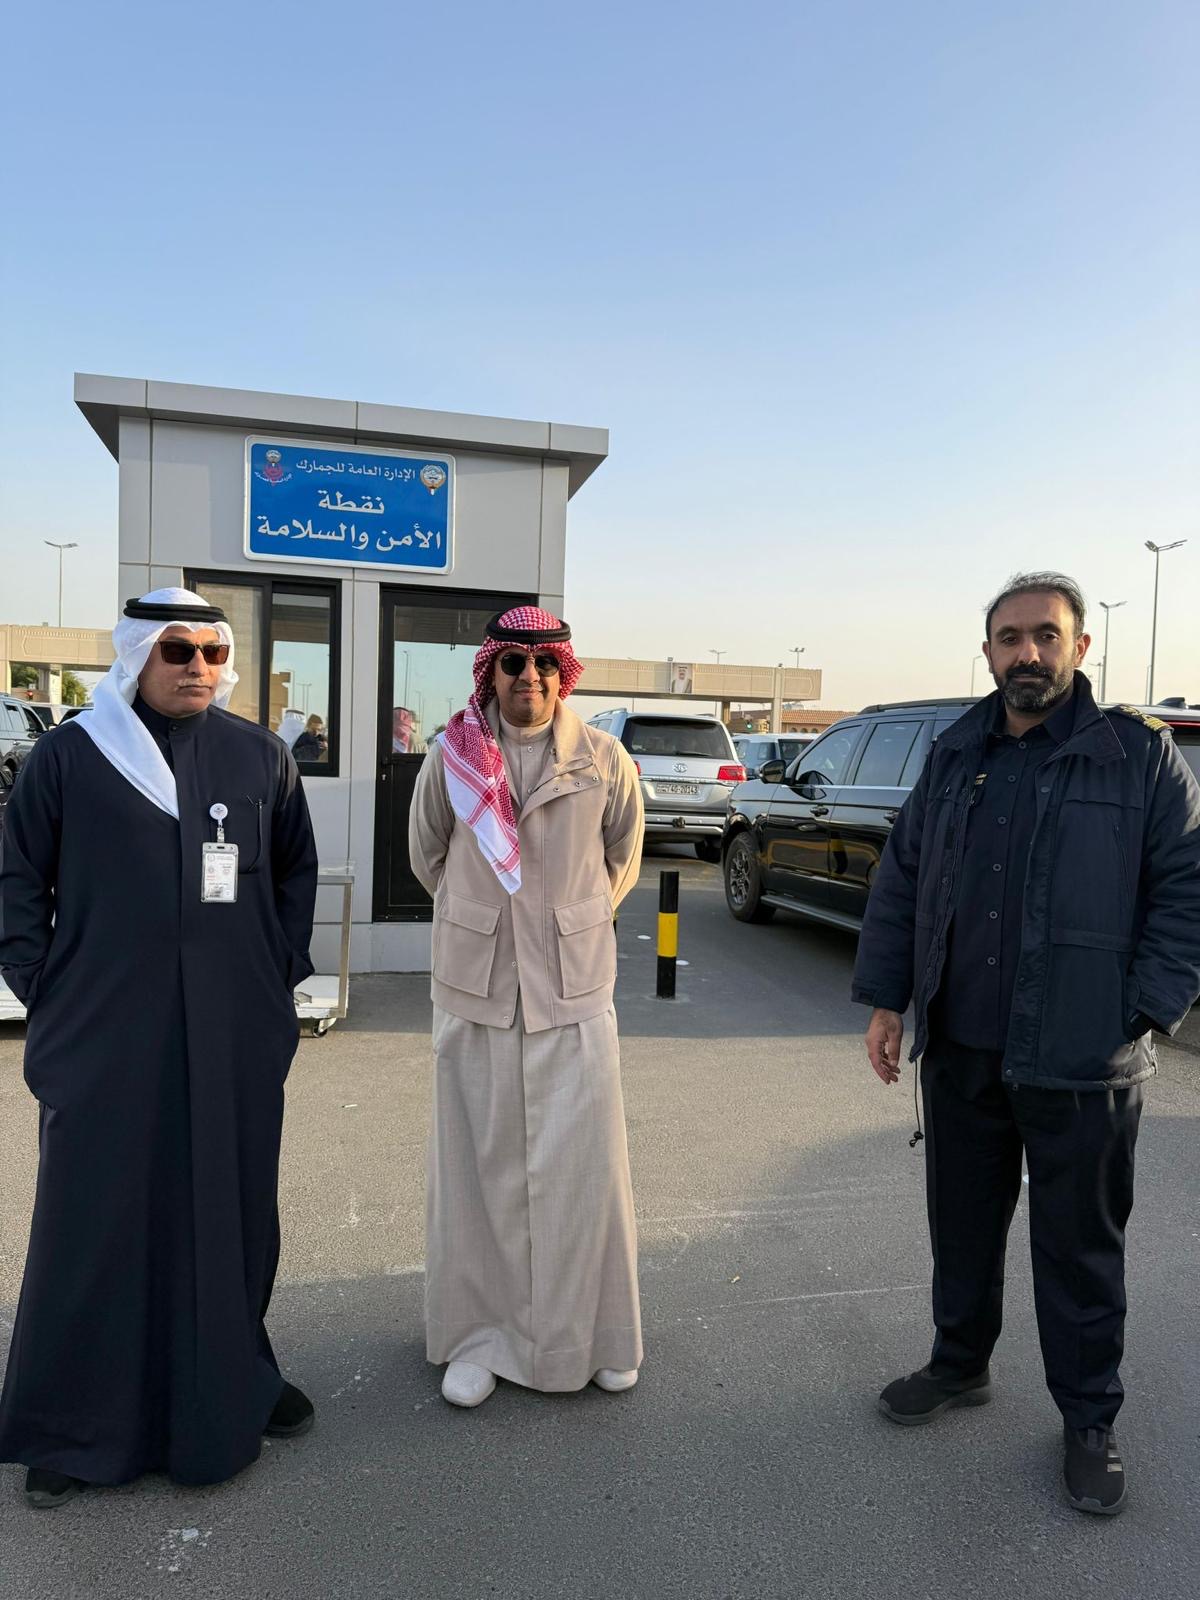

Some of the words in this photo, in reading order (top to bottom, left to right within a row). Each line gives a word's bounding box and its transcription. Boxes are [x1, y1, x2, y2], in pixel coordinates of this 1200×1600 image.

[296, 459, 345, 473] للجمارك
[348, 464, 382, 476] العامة
[384, 468, 416, 482] الإدارة
[318, 489, 385, 514] نقطة
[256, 515, 369, 550] والسلامة
[375, 522, 441, 552] الأمن
